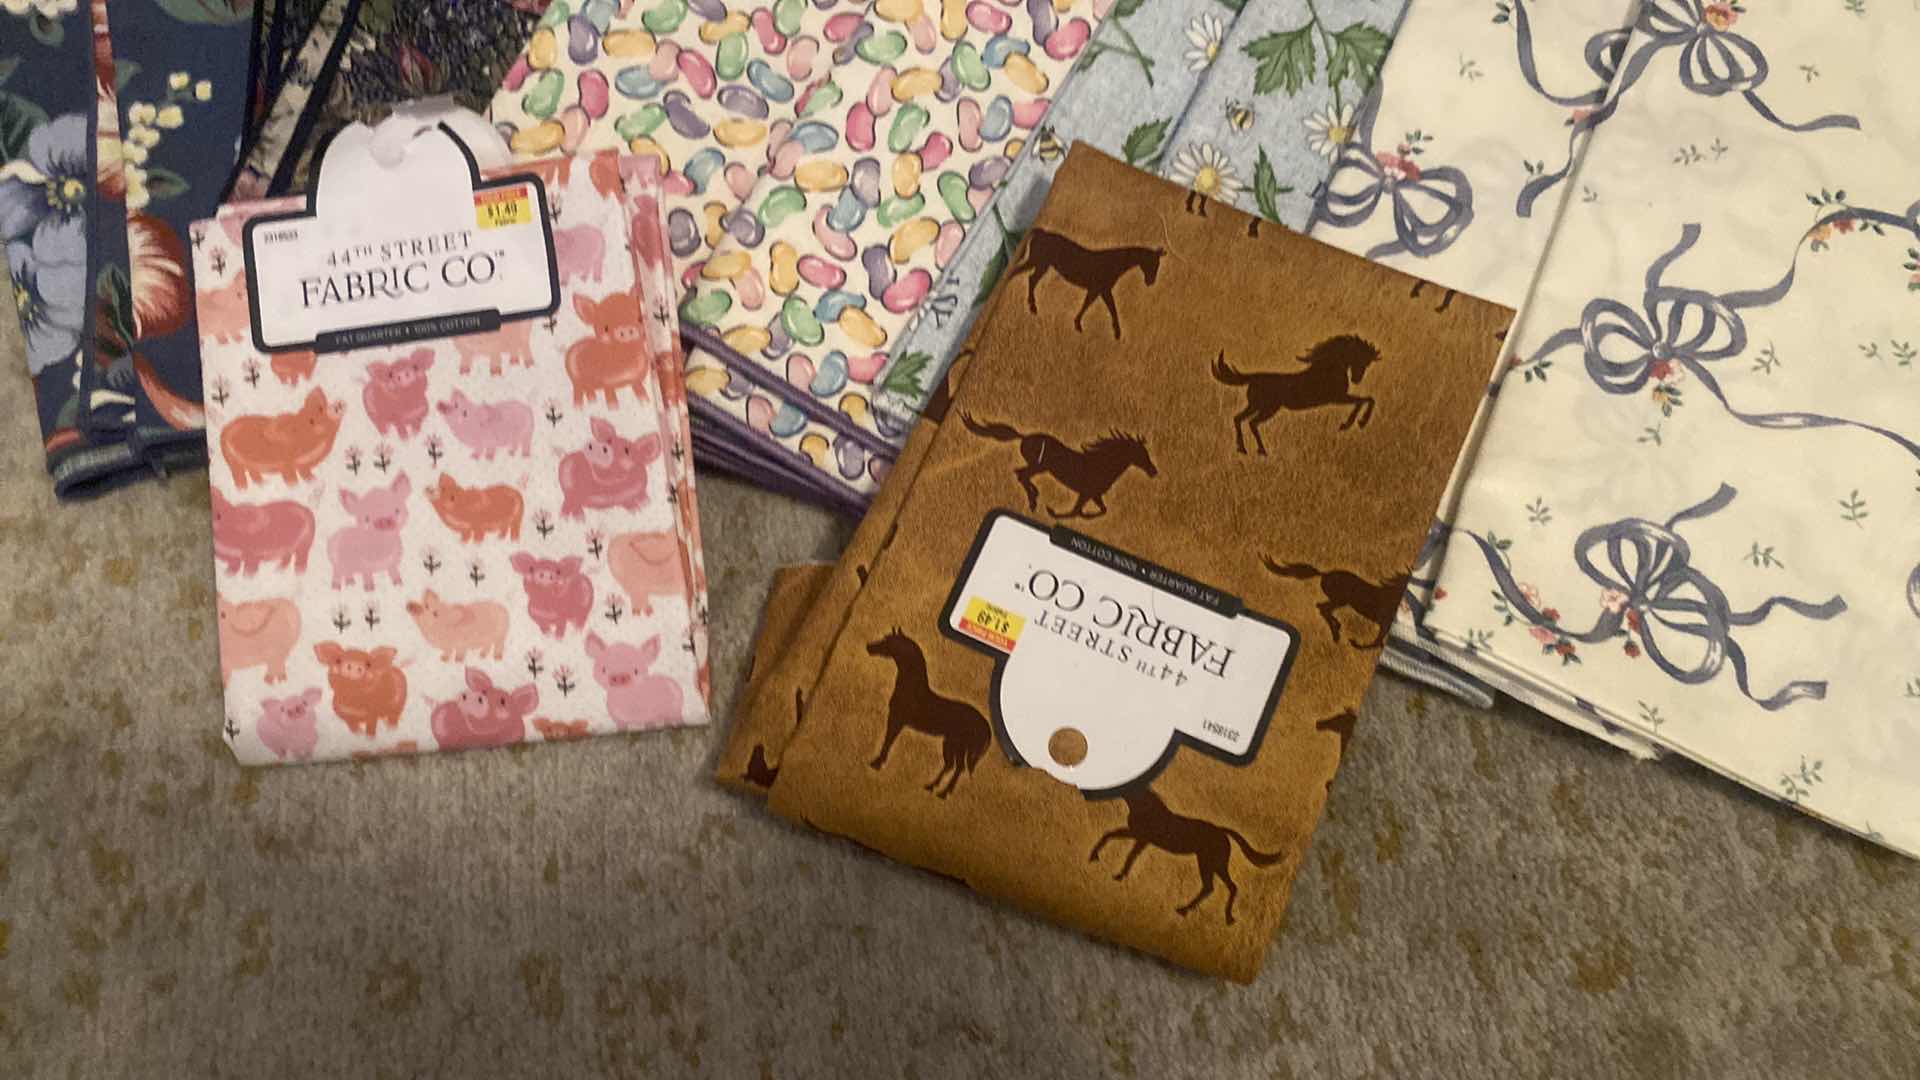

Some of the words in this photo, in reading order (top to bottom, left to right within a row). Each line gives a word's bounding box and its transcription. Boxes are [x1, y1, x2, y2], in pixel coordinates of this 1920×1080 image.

[487, 202, 518, 219] $1.49
[327, 245, 373, 267] 44TH
[380, 230, 473, 262] STREET
[300, 262, 430, 309] FABRIC
[356, 325, 402, 342] QUARTER
[440, 316, 481, 333] COTTON
[1070, 536, 1113, 561] COTTON
[1149, 568, 1198, 595] QUARTER
[977, 609, 1010, 633] $1.49
[1033, 609, 1133, 663] STREET
[1092, 595, 1236, 679] FABRIC
[1136, 657, 1188, 688] 44TH
